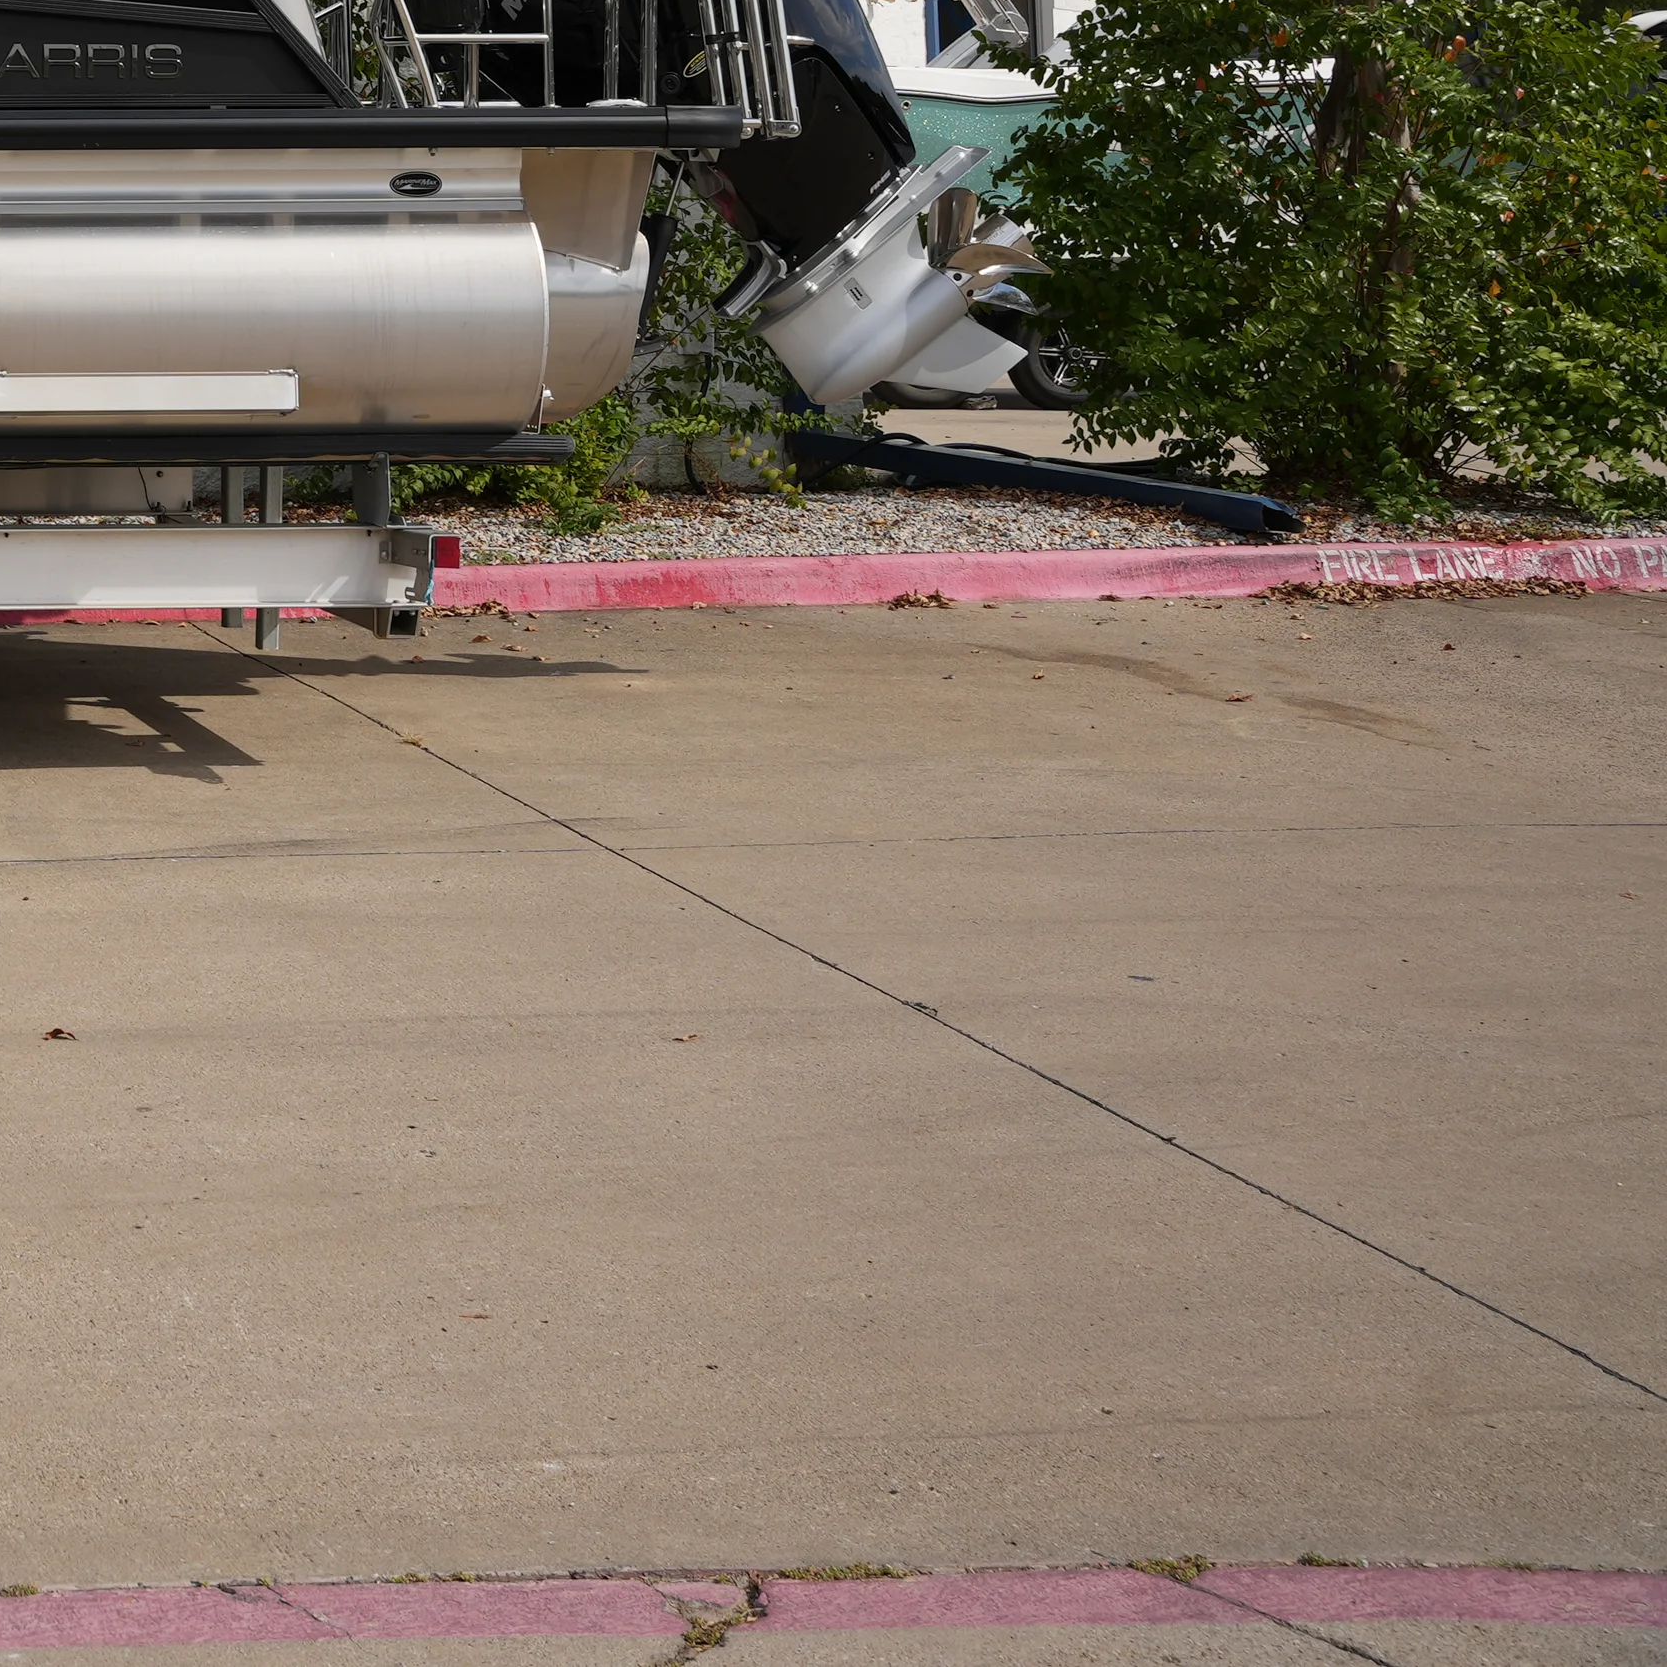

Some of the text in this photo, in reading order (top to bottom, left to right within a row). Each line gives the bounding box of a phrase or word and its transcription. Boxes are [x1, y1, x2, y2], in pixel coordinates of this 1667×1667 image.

[1318, 548, 1400, 582] FIRE
[1406, 546, 1505, 581] LANE
[1569, 545, 1622, 579] NO
